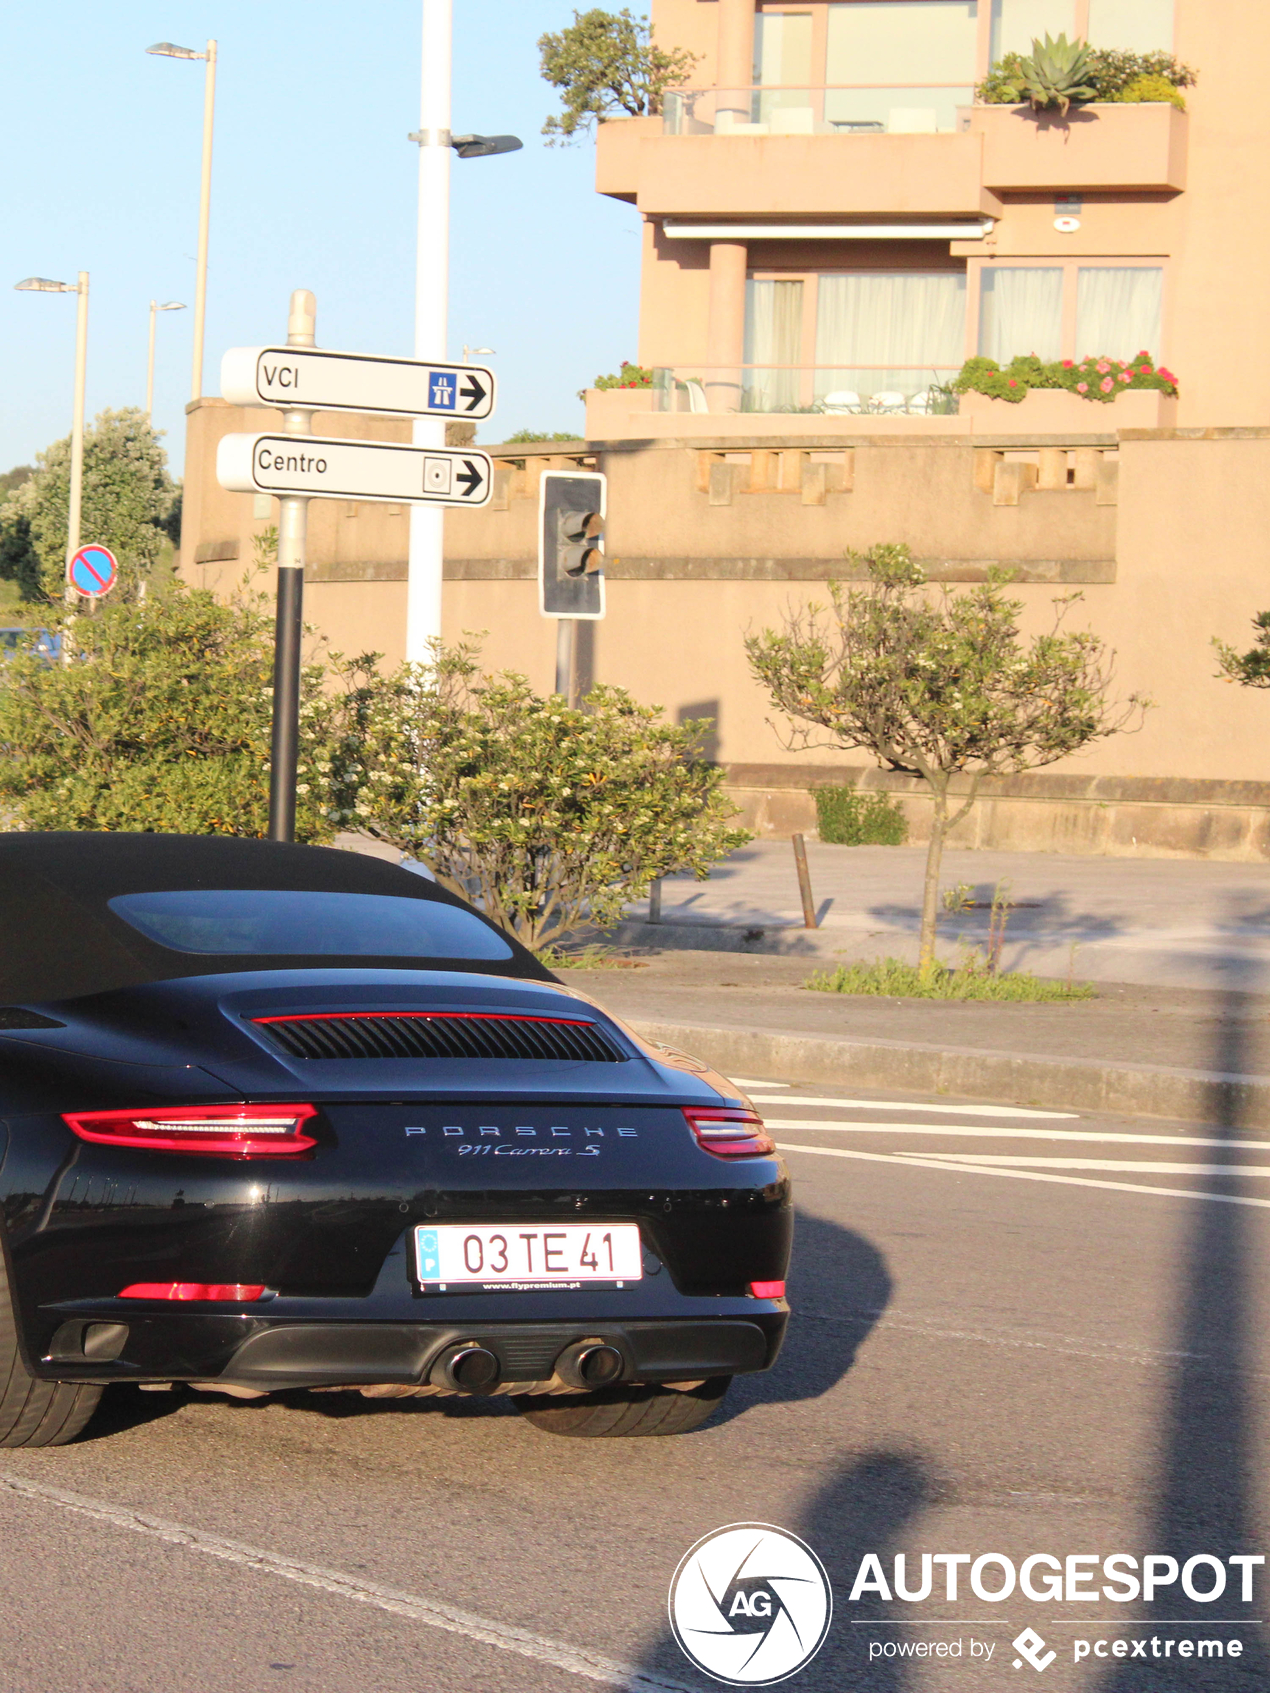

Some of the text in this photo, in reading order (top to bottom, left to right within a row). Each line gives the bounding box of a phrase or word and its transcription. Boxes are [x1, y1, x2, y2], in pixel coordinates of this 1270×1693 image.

[263, 366, 298, 388] VCI
[258, 449, 327, 474] Centro
[404, 1126, 638, 1137] PORSCHE
[458, 1144, 601, 1156] 911 Carrera S
[463, 1232, 614, 1274] 03 TE 41
[482, 1281, 581, 1290] www.flypremium.pt
